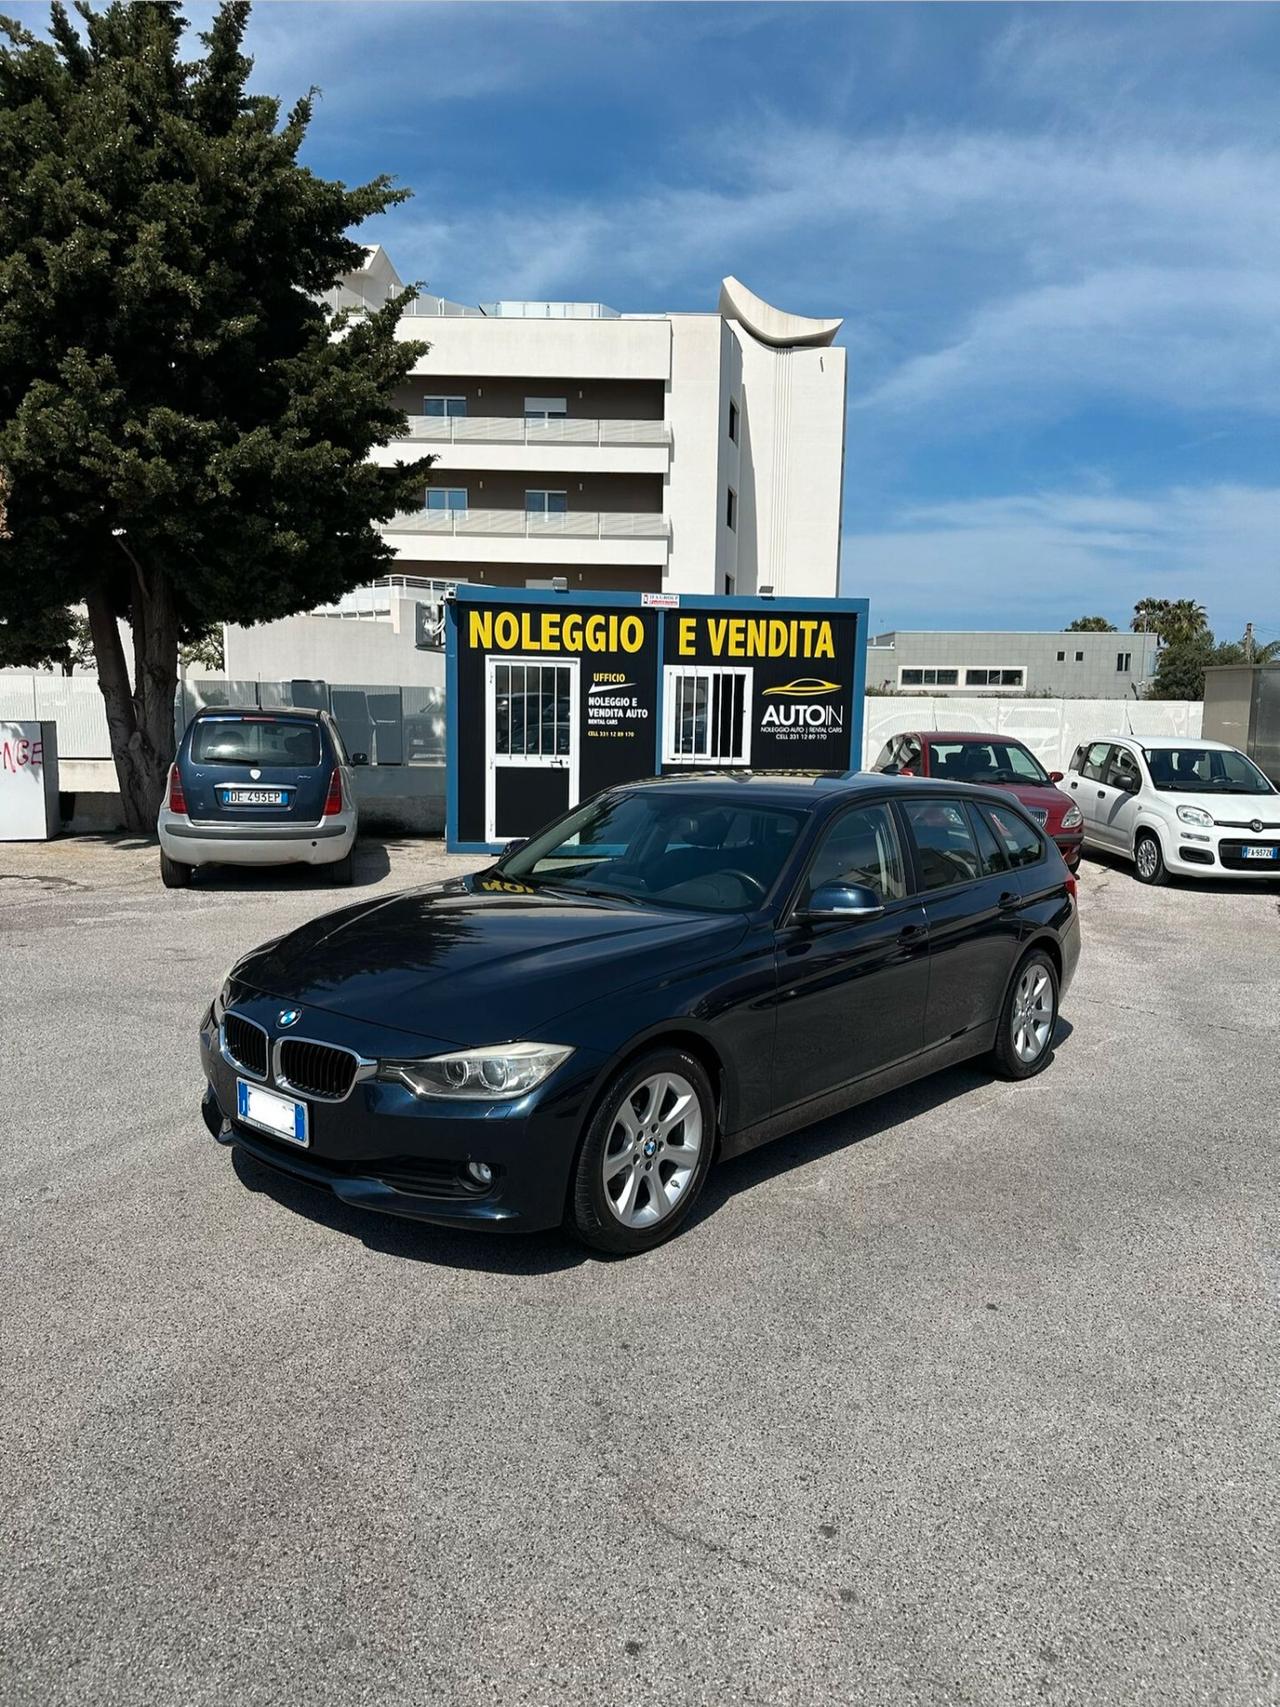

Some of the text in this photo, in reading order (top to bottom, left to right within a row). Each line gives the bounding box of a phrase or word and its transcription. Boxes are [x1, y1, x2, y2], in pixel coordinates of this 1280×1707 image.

[469, 610, 836, 659] NOLEGGIO E VENDITA
[593, 673, 625, 682] UFFICIO
[588, 697, 638, 707] NOLEGGIO E
[588, 708, 648, 718] VENDITA AUTO
